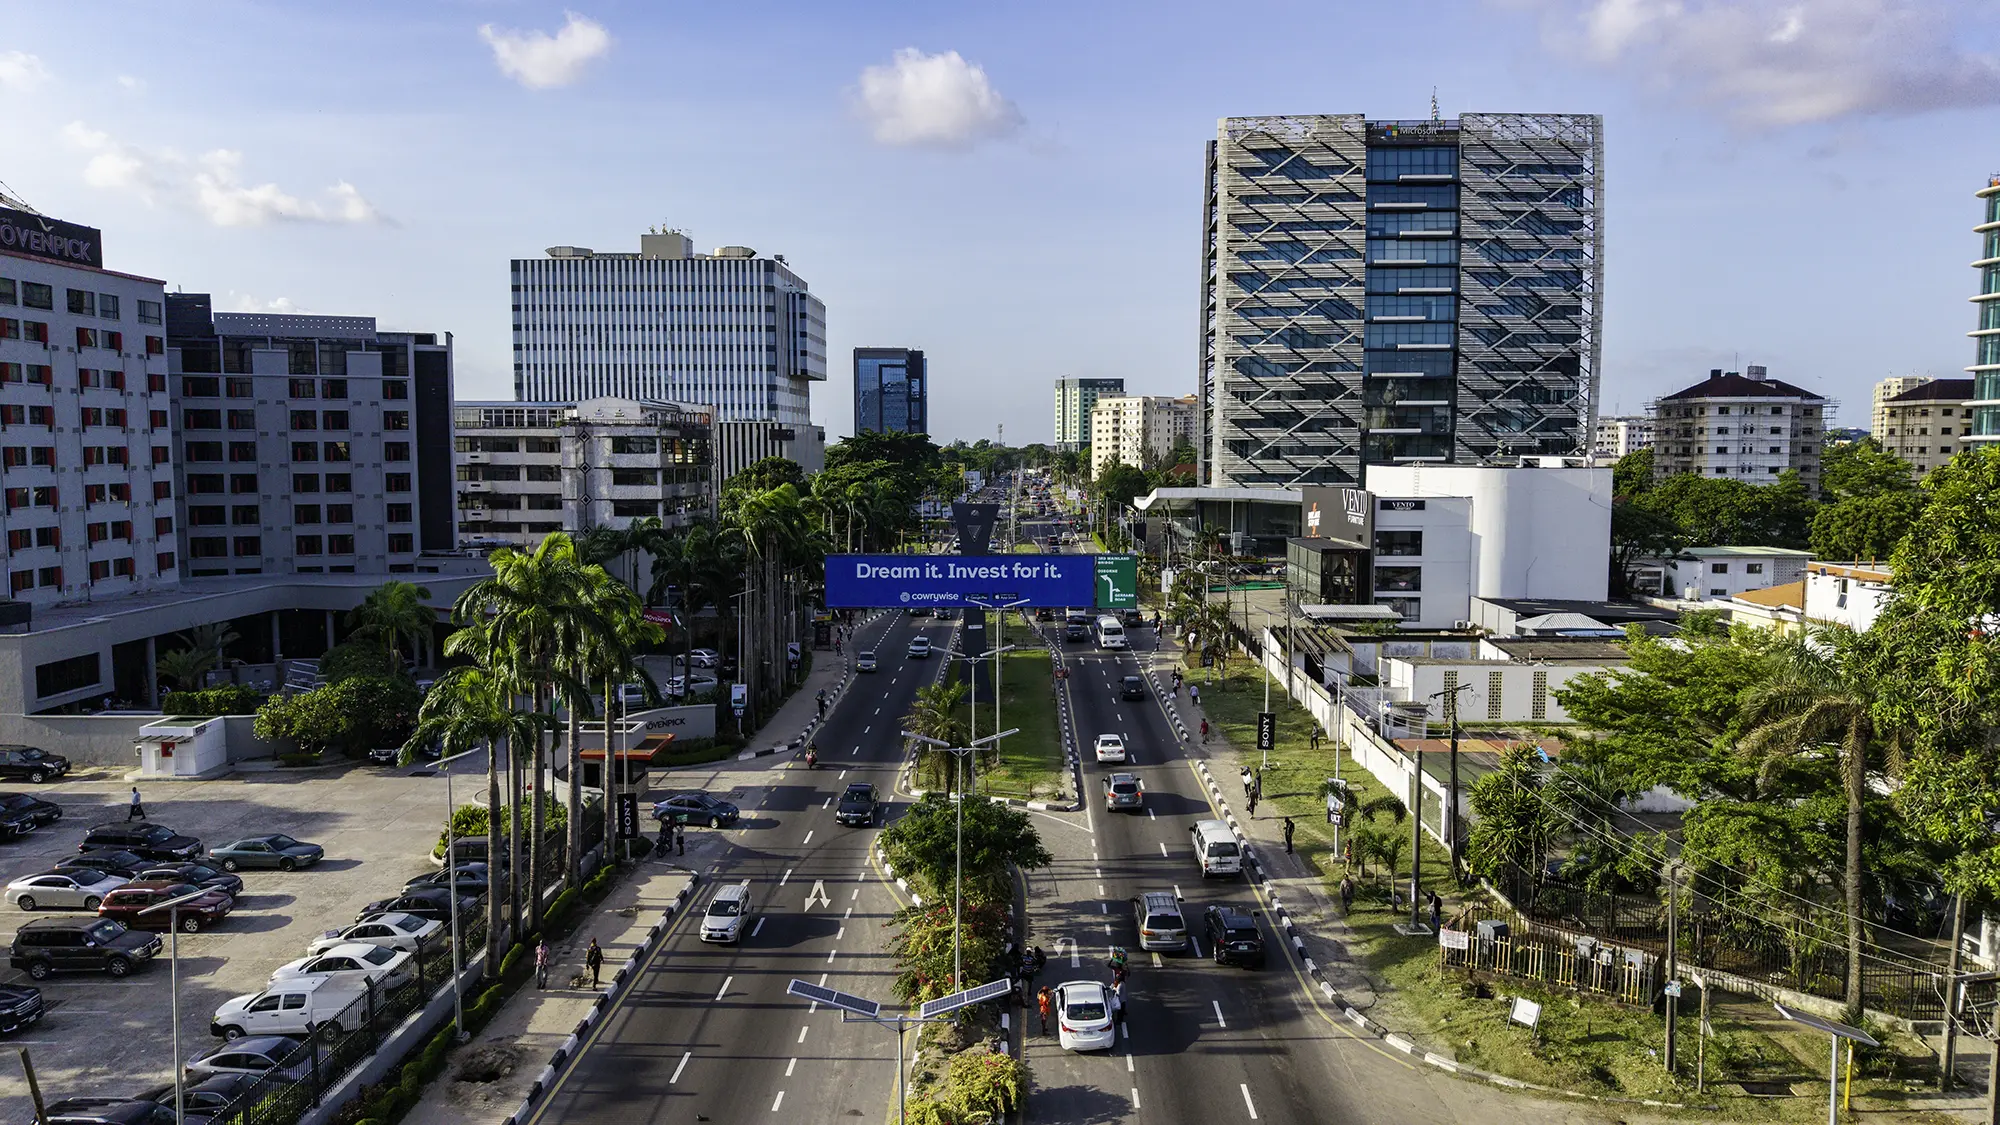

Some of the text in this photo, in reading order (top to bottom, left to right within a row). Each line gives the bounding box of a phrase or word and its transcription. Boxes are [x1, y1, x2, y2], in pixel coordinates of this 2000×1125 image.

[1400, 127, 1438, 135] Microsoft
[0, 217, 92, 261] ÖVENPICK
[1342, 488, 1367, 514] VENTO
[856, 562, 1062, 579] Dream it. Invest for it.
[911, 591, 959, 602] cowrywise
[1262, 717, 1270, 747] SONY
[624, 798, 632, 835] SONY
[1330, 813, 1341, 824] ULT
